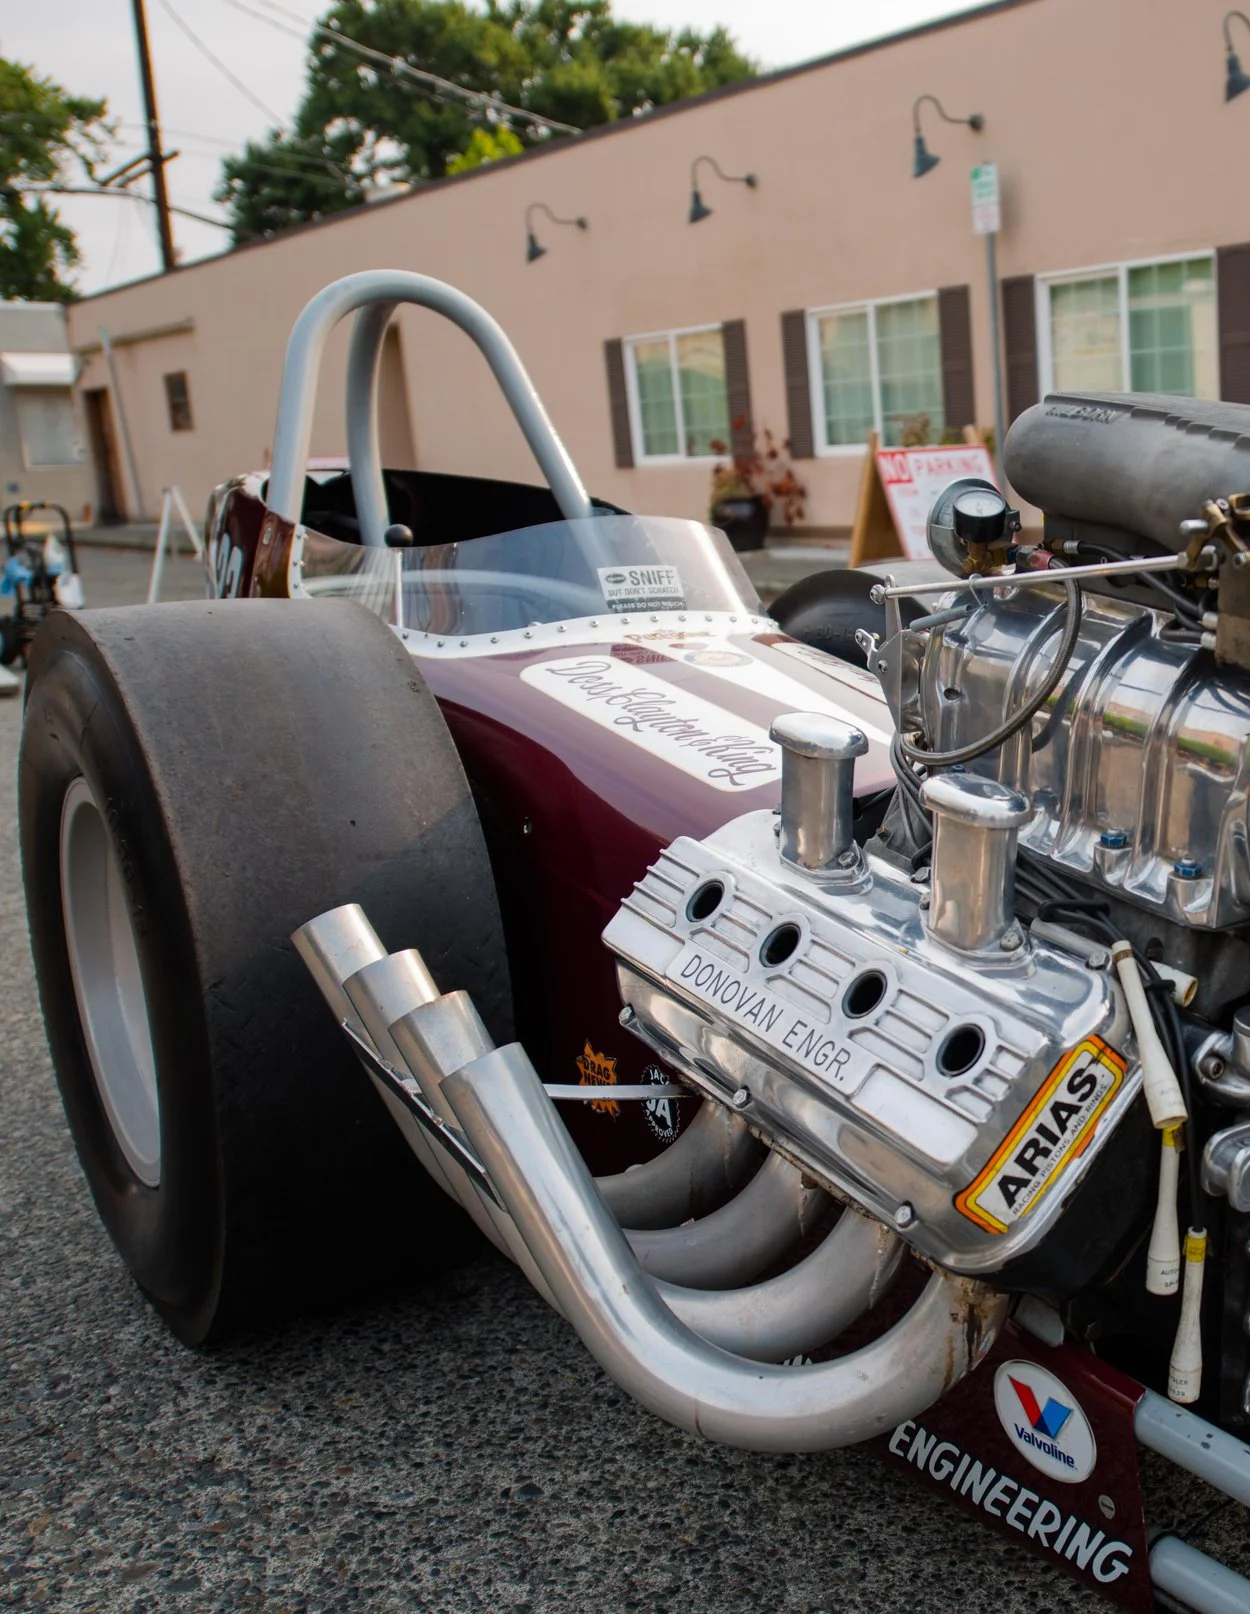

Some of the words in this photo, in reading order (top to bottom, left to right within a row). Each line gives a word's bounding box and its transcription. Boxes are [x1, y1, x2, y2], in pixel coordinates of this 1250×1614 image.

[879, 453, 911, 481] NO
[624, 587, 645, 596] DON'T
[648, 586, 679, 594] SCRATCH
[628, 569, 675, 586] SNIFF
[681, 954, 784, 1033] DONOVAN
[782, 1019, 852, 1082] ENGR.
[997, 1064, 1098, 1209] ARIAS
[1013, 1180, 1041, 1216] RACING
[1041, 1138, 1071, 1178] PISTONS
[1071, 1115, 1087, 1136] AND
[1014, 1422, 1076, 1470] Valvoline
[888, 1419, 1134, 1583] ENGINEERING
